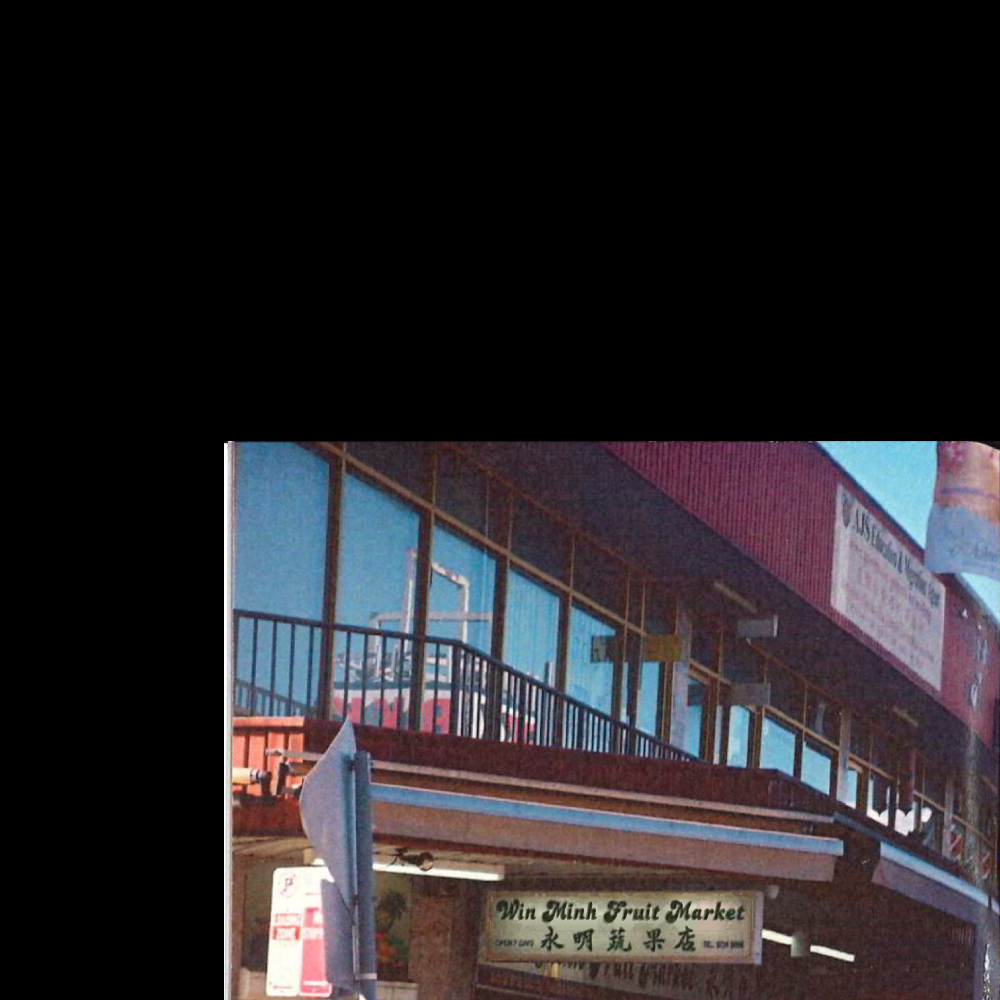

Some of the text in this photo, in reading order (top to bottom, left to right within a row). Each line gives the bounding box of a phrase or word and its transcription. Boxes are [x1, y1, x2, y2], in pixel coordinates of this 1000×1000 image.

[496, 899, 745, 924] Win Minh Fruit Market
